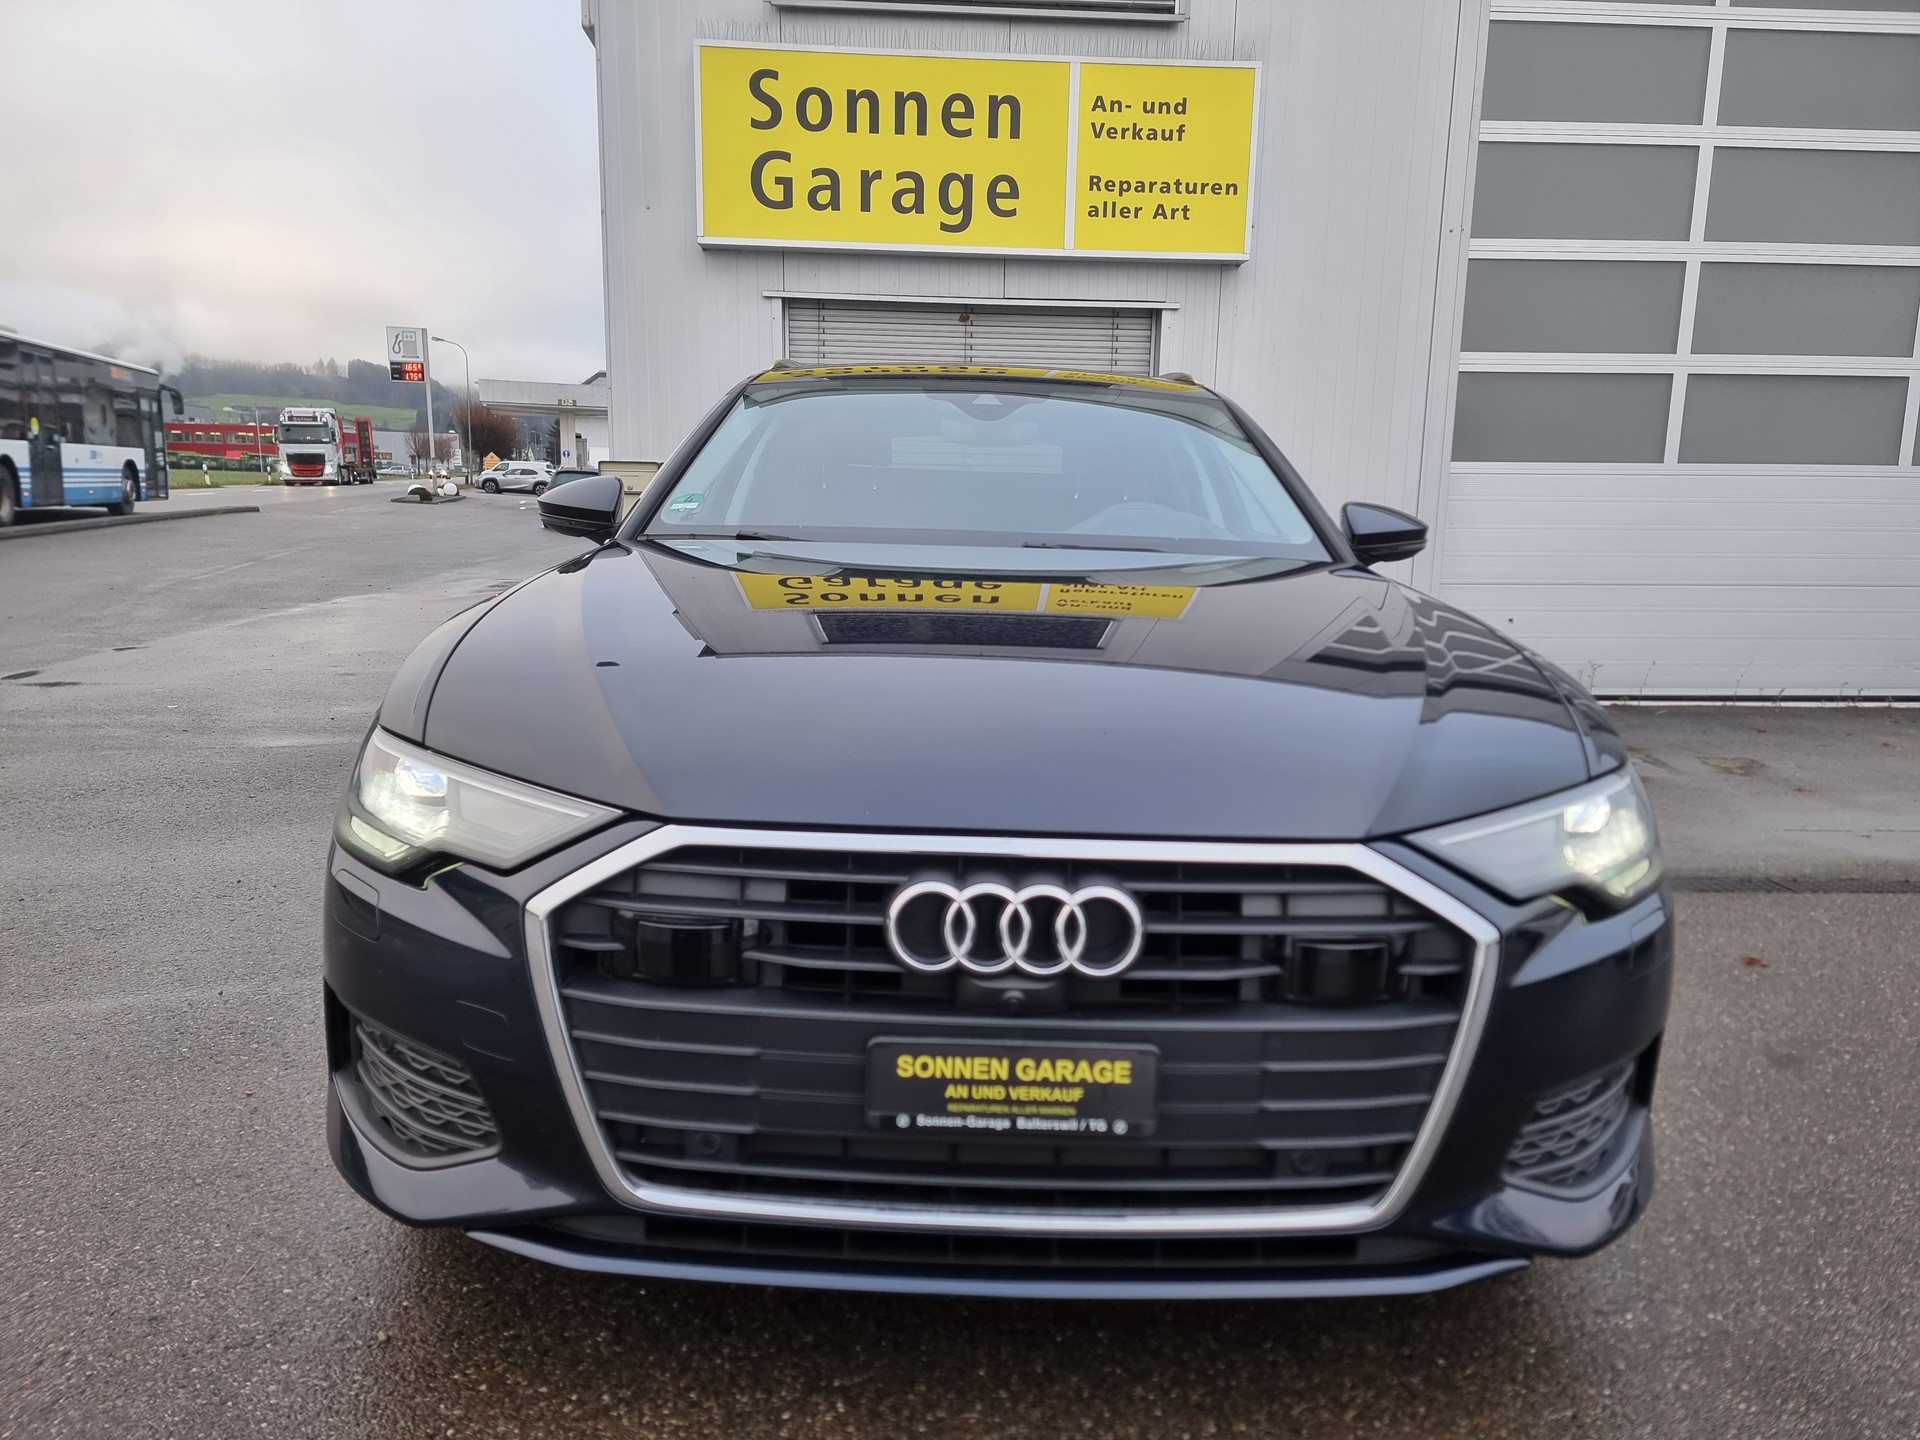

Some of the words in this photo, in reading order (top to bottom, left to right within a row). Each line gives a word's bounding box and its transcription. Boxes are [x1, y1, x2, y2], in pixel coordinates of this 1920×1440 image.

[748, 68, 1021, 140] Sonnen
[1090, 95, 1132, 113] An-
[1142, 97, 1188, 116] und
[1090, 121, 1186, 142] Verkauf
[750, 150, 1020, 234] Garage
[1088, 175, 1238, 197] Reparaturen
[1087, 200, 1143, 219] aller
[1152, 203, 1191, 221] Art
[896, 1054, 1009, 1081] SONNEN
[1015, 1058, 1132, 1084] GARAGE
[944, 1083, 968, 1099] AN
[971, 1084, 1006, 1101] UND
[1008, 1085, 1085, 1103] VERKAUF
